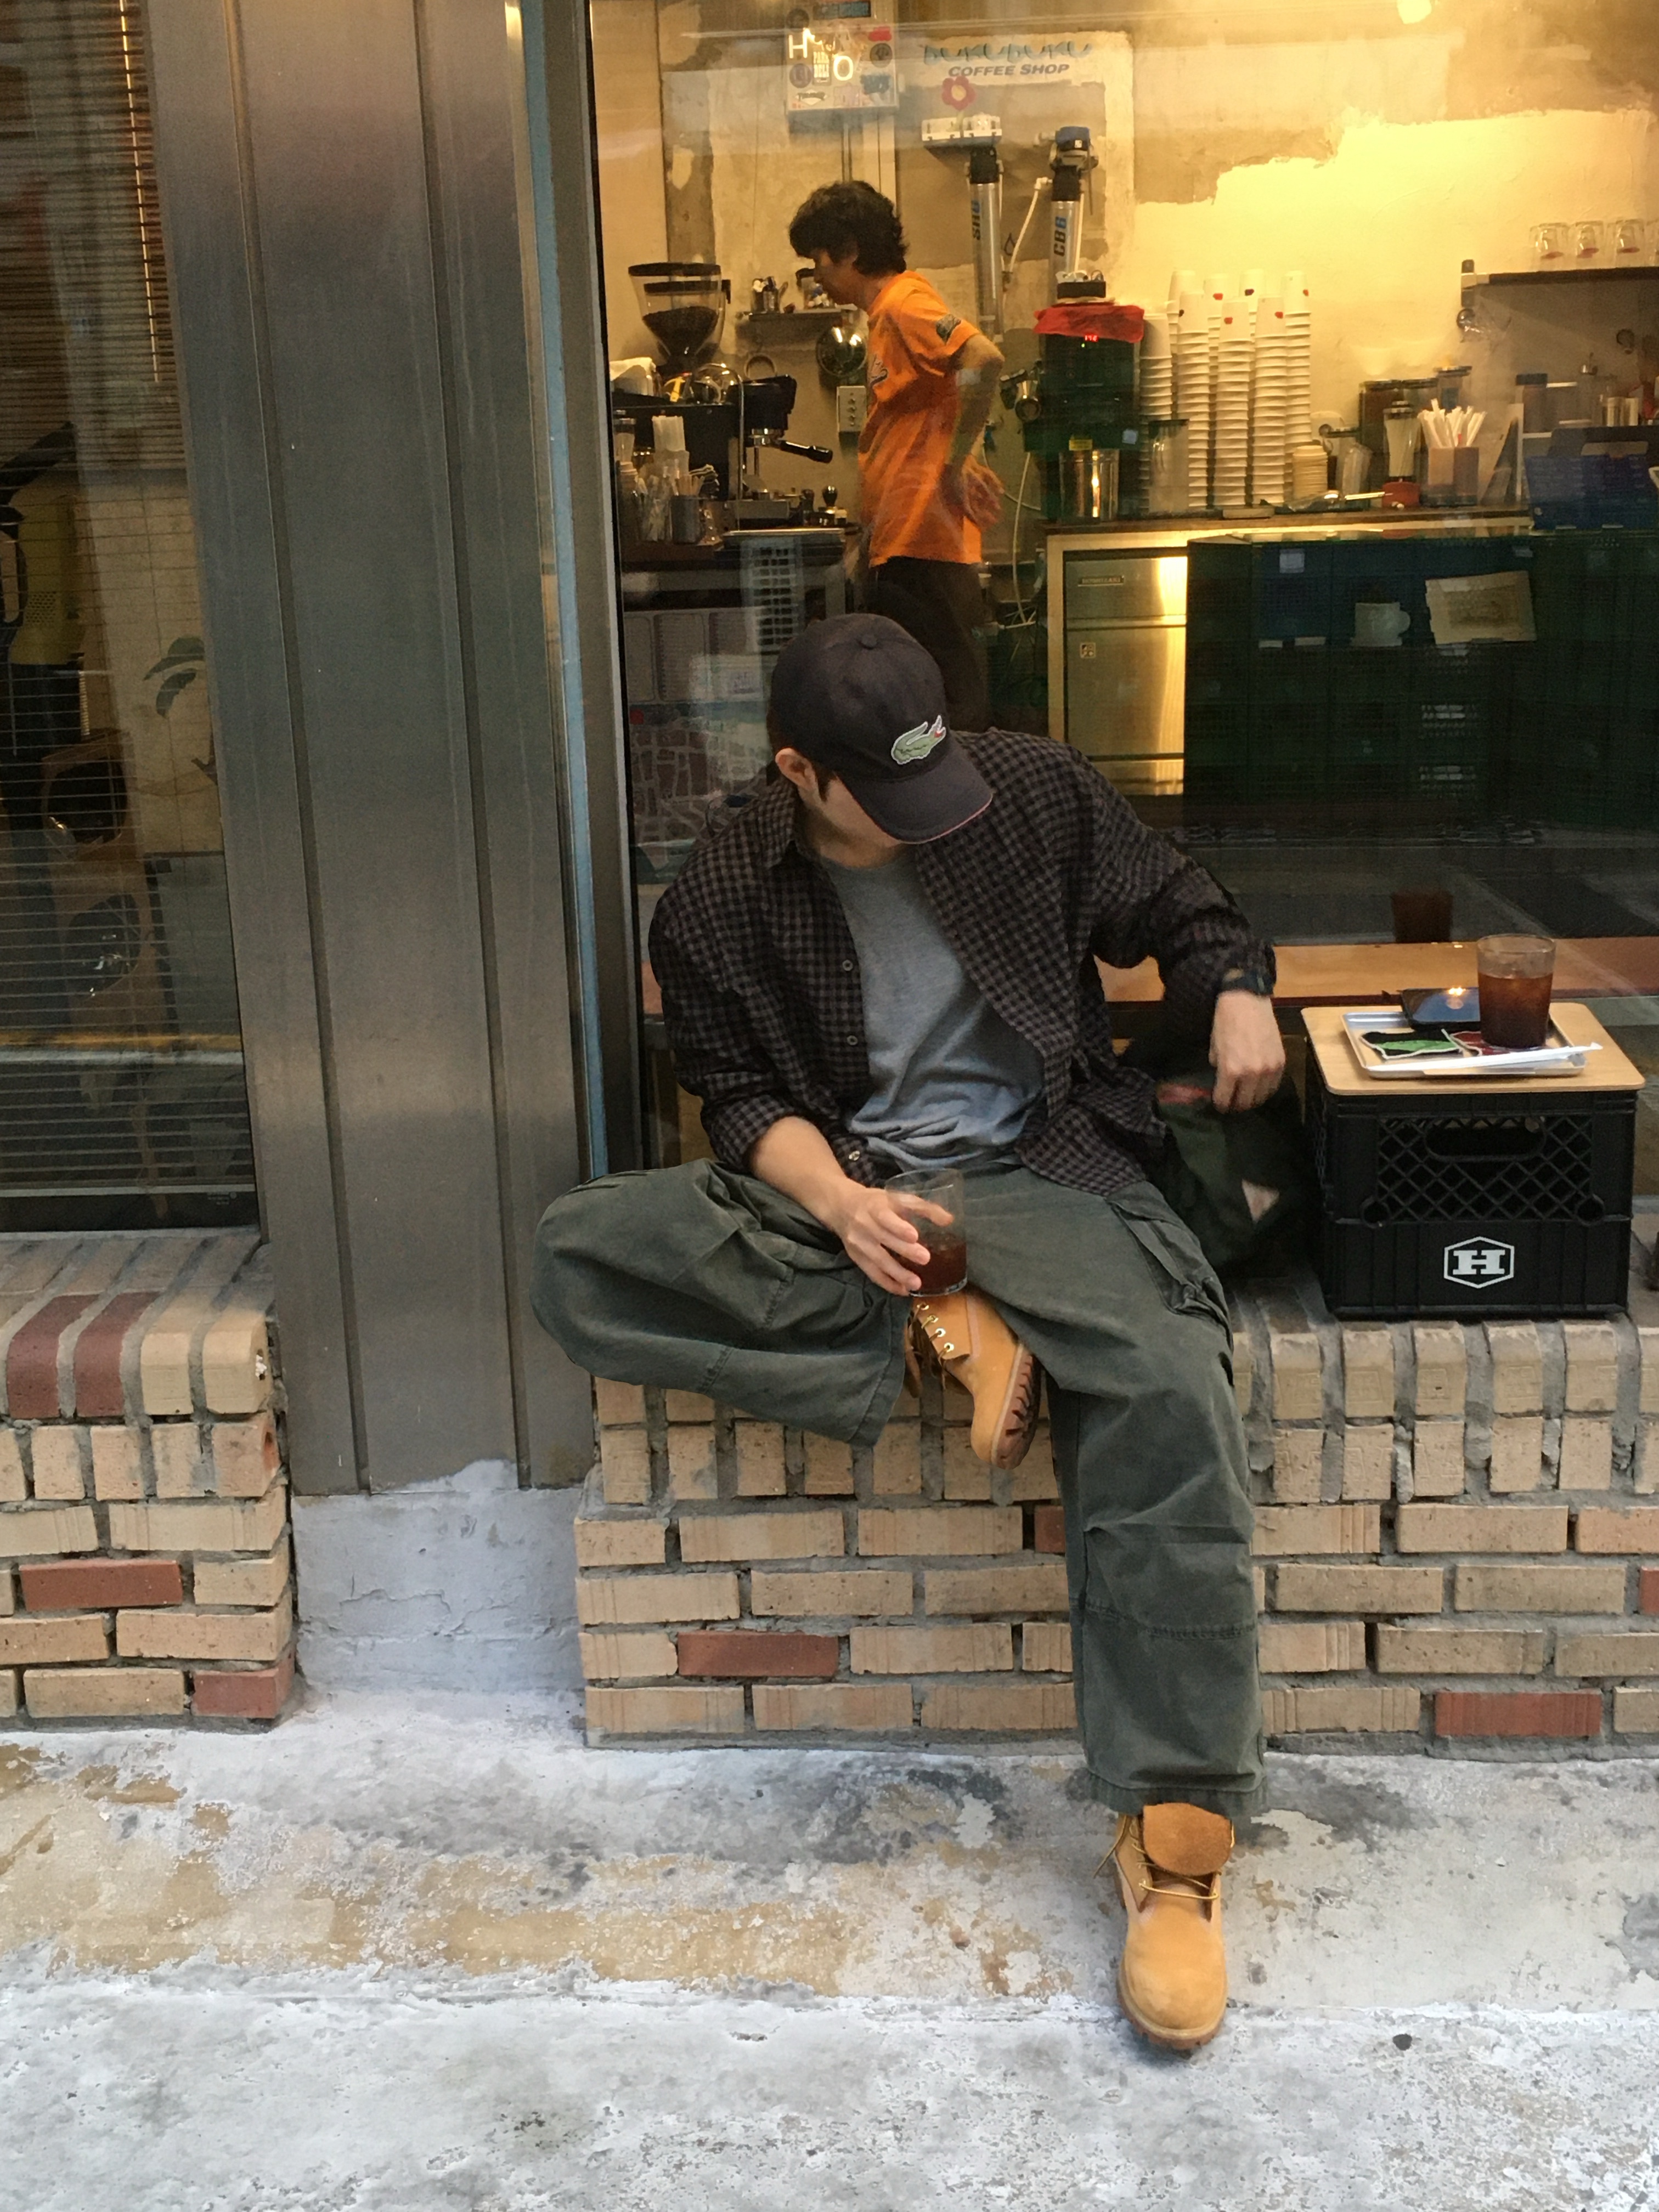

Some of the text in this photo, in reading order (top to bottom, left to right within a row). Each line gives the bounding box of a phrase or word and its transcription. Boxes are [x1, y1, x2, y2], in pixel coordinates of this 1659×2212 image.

[948, 64, 1070, 77] COFFEE SHOP
[1453, 1249, 1505, 1275] H
